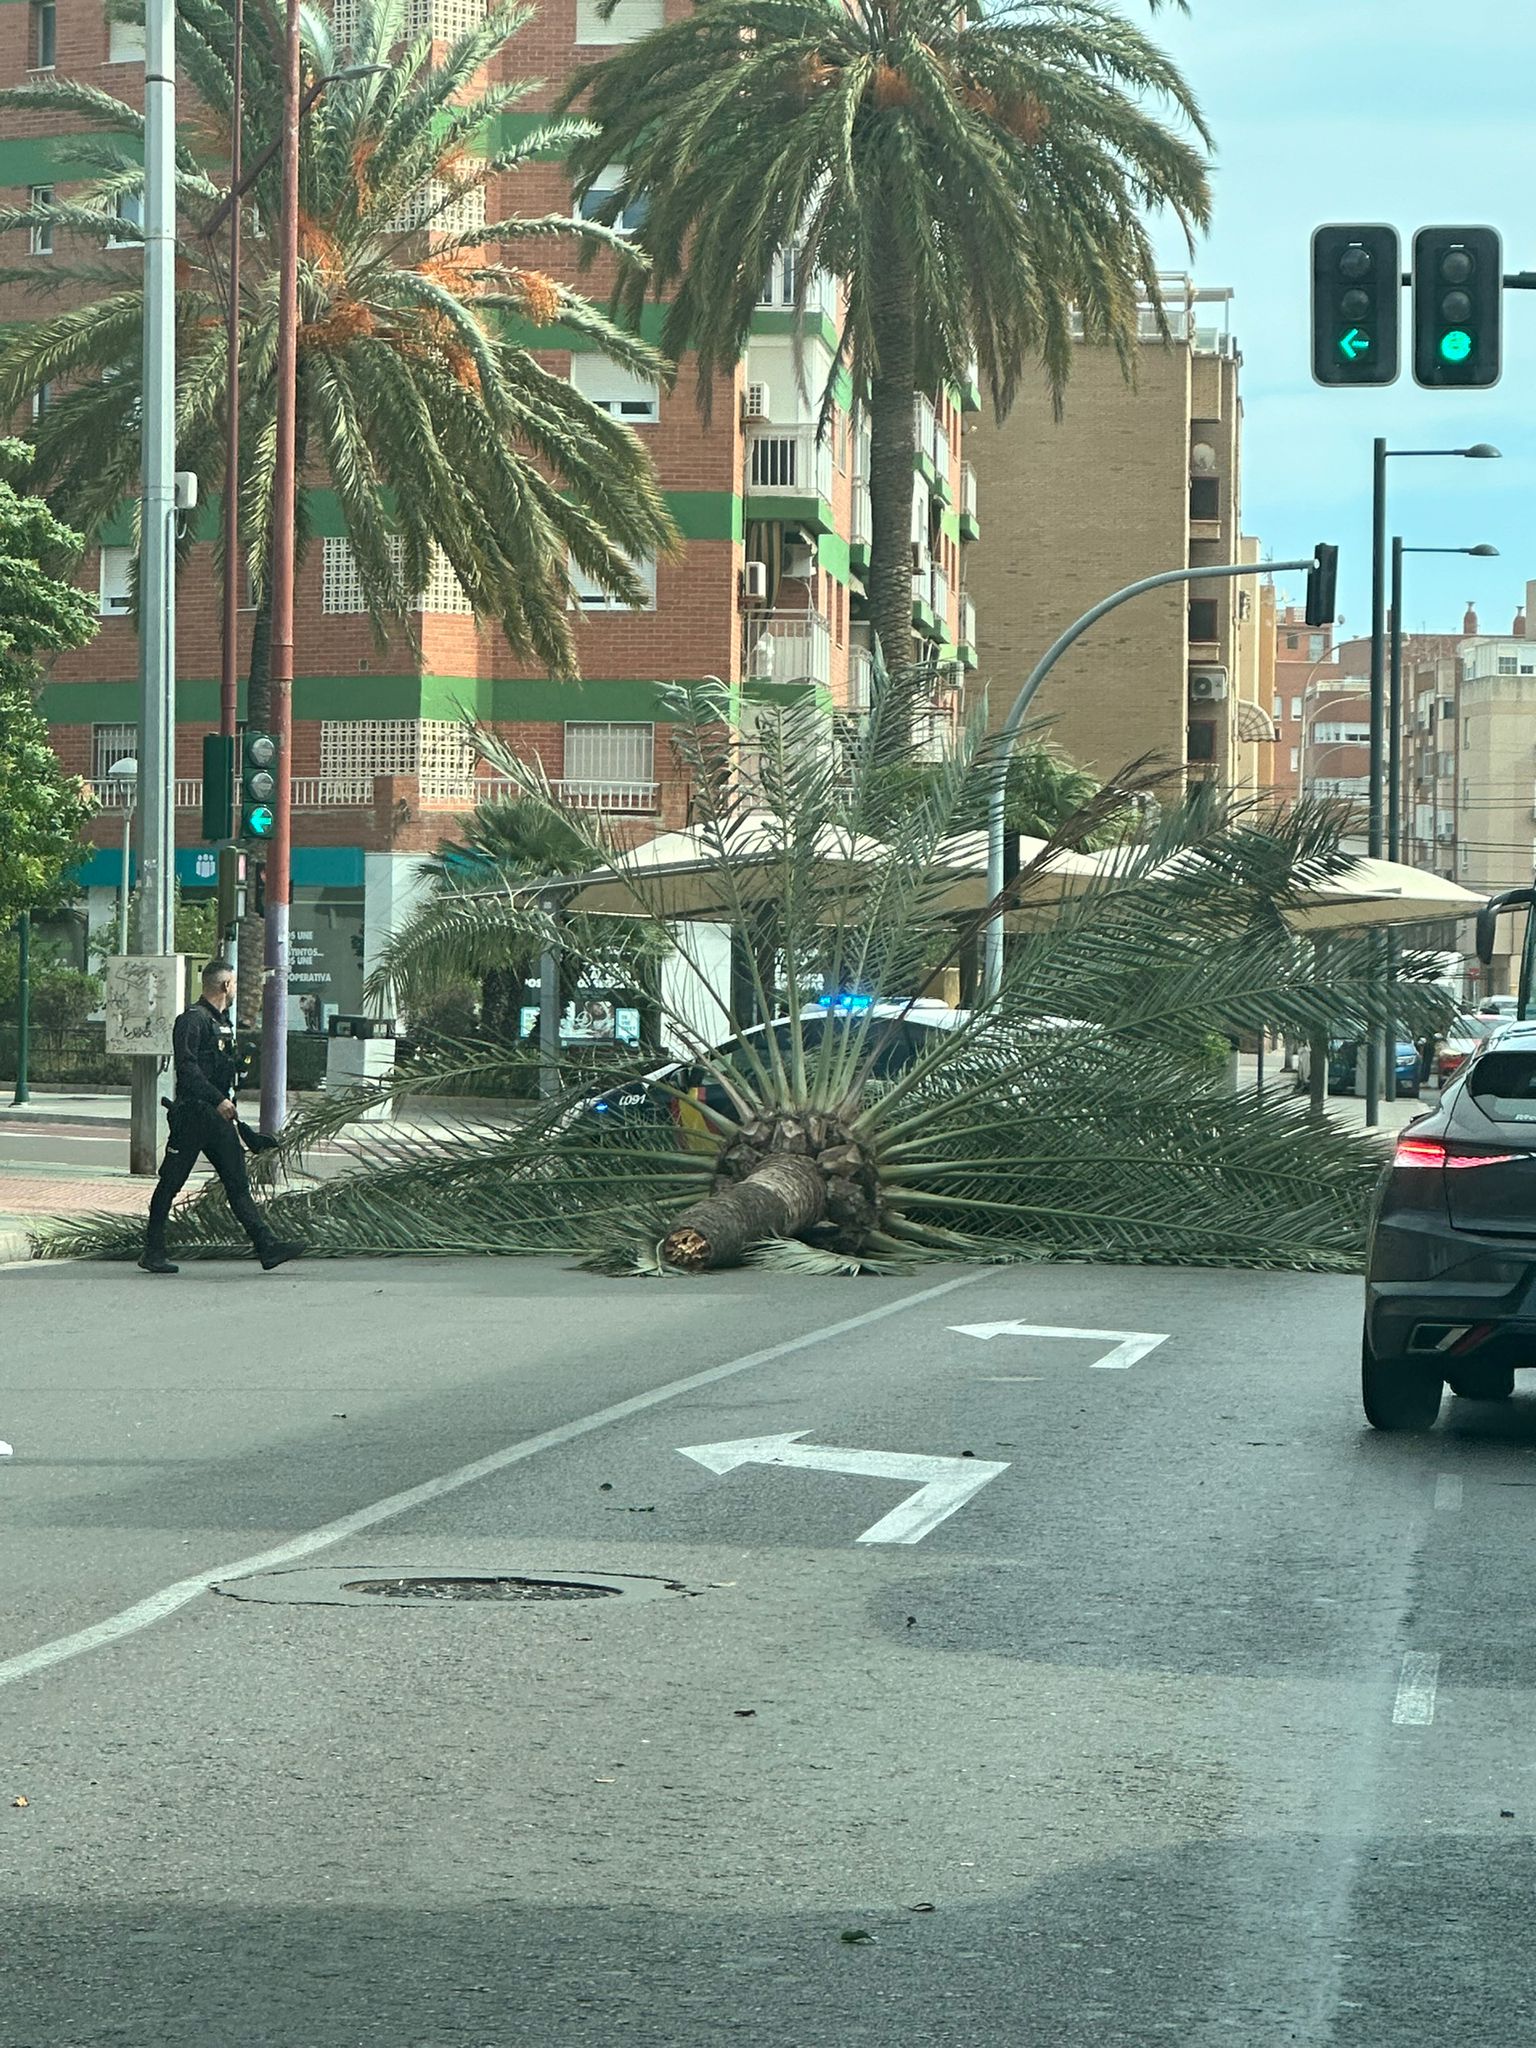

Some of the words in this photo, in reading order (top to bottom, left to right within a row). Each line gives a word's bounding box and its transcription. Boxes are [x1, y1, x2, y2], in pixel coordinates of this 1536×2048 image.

[297, 931, 313, 940] UNE
[297, 957, 313, 965] UNE
[288, 973, 332, 982] OPERATIVA
